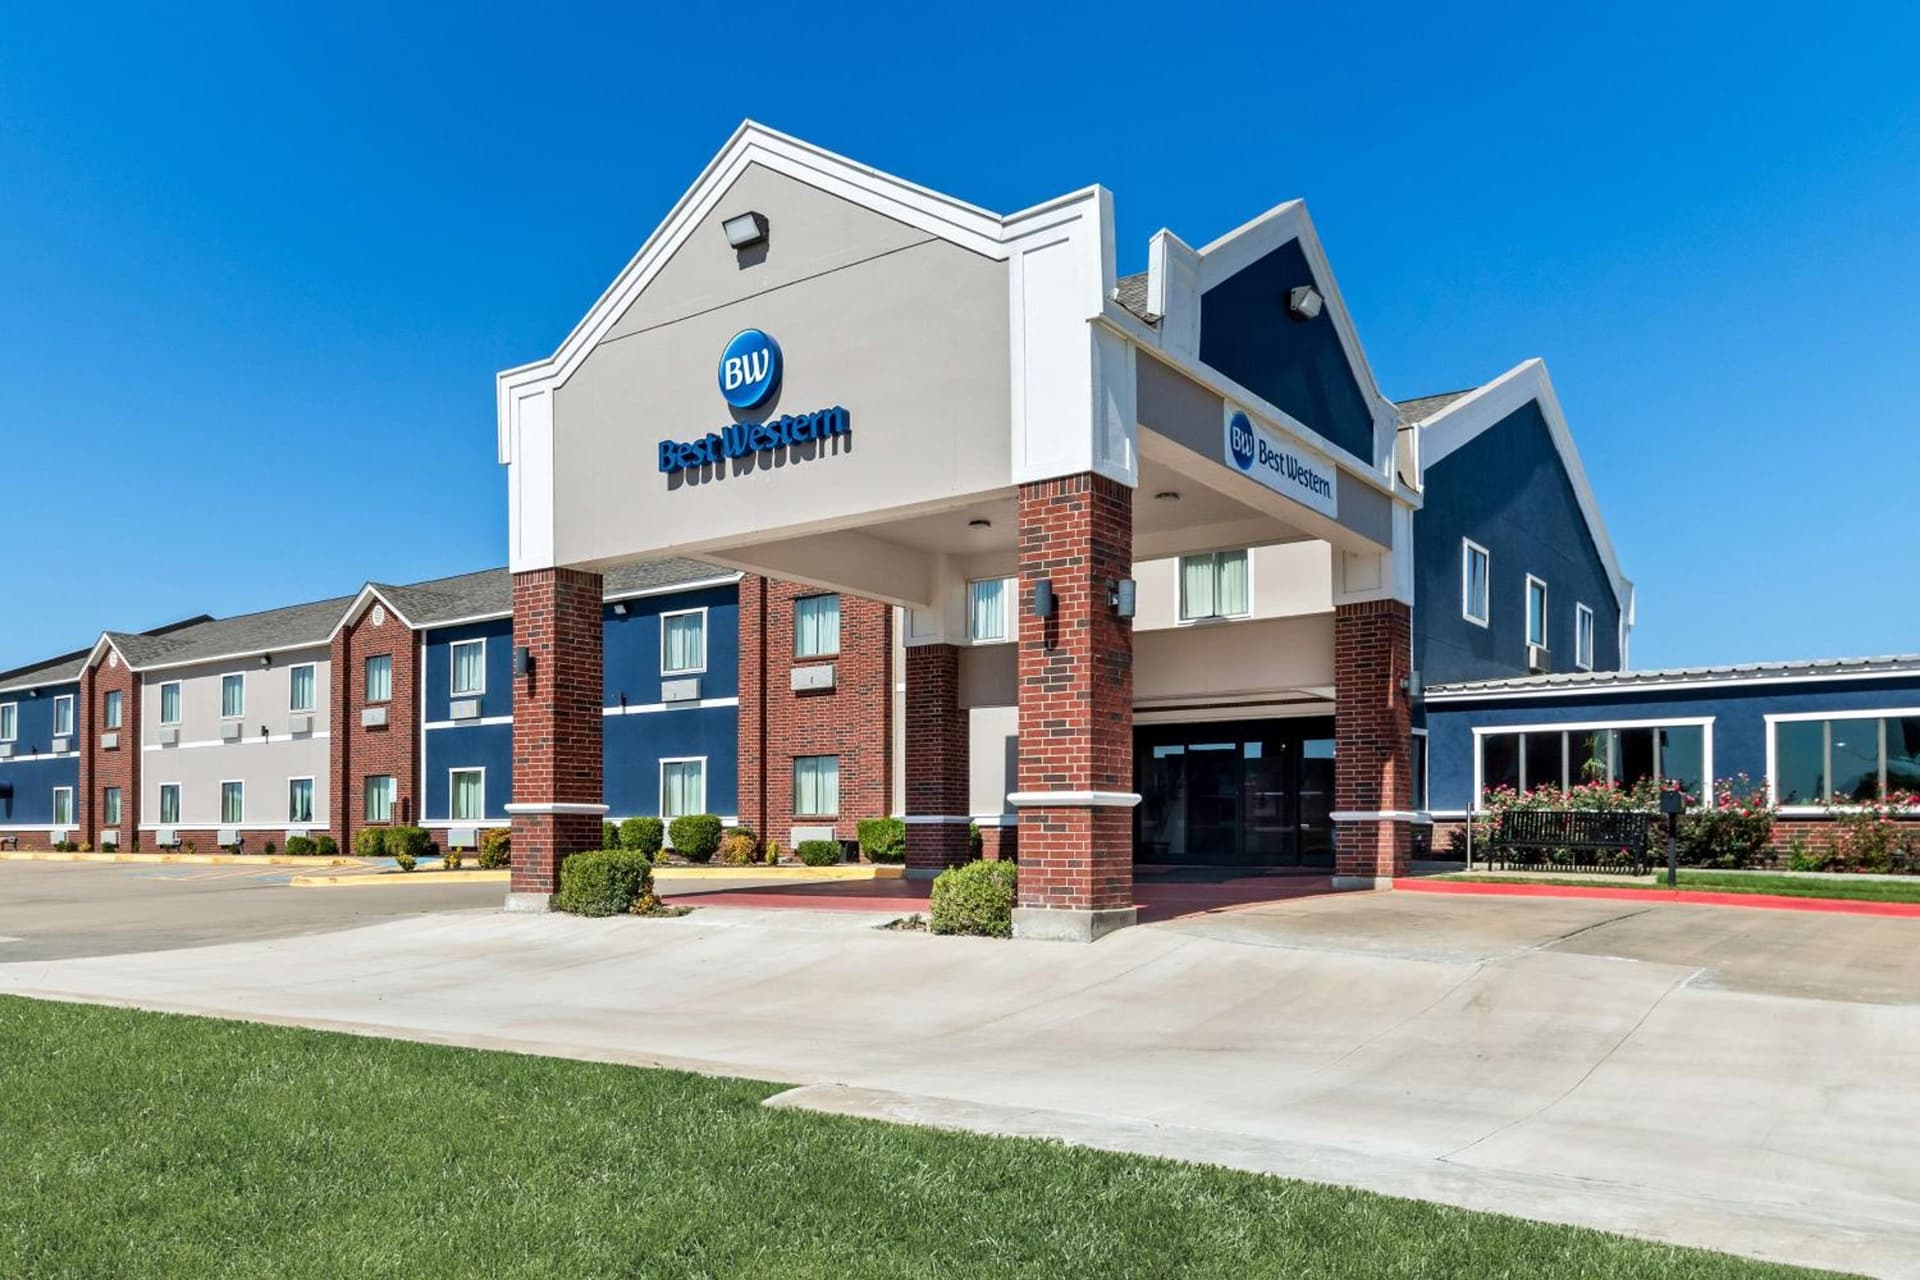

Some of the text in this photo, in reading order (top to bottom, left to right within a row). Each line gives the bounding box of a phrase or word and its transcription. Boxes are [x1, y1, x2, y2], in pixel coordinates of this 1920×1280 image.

[725, 348, 769, 390] BW
[658, 405, 850, 473] Best Western
[1232, 426, 1253, 457] BW
[1258, 438, 1331, 499] Best Western
